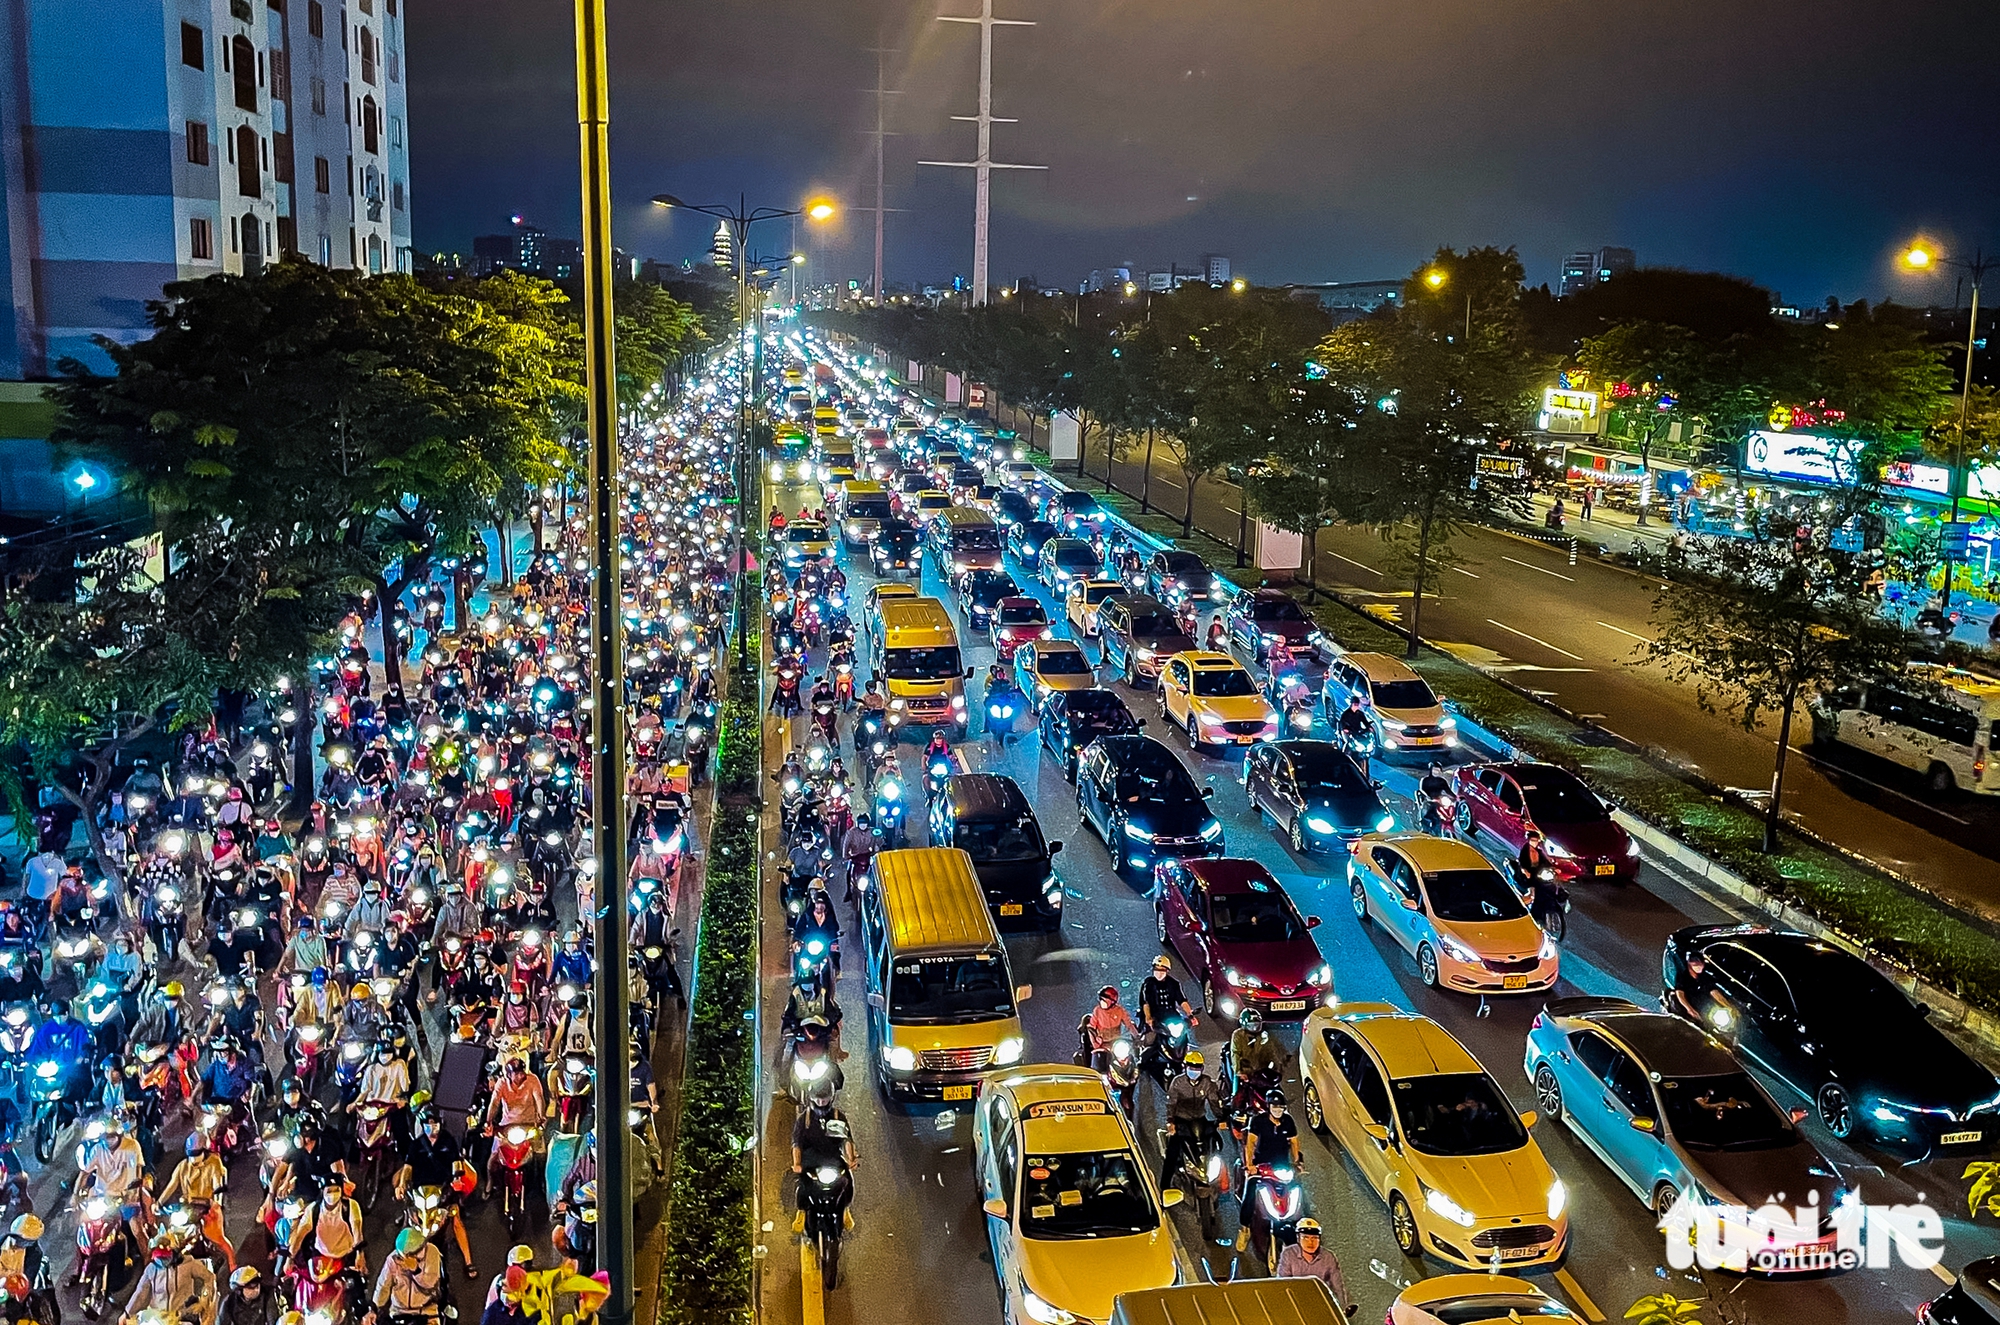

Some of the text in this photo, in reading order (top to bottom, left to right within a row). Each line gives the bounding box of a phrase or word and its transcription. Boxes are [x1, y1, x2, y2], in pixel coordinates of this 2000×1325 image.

[919, 956, 954, 964] TOYOTA
[572, 1033, 585, 1050] 13
[1046, 1101, 1101, 1112] VINASUN TAXI
